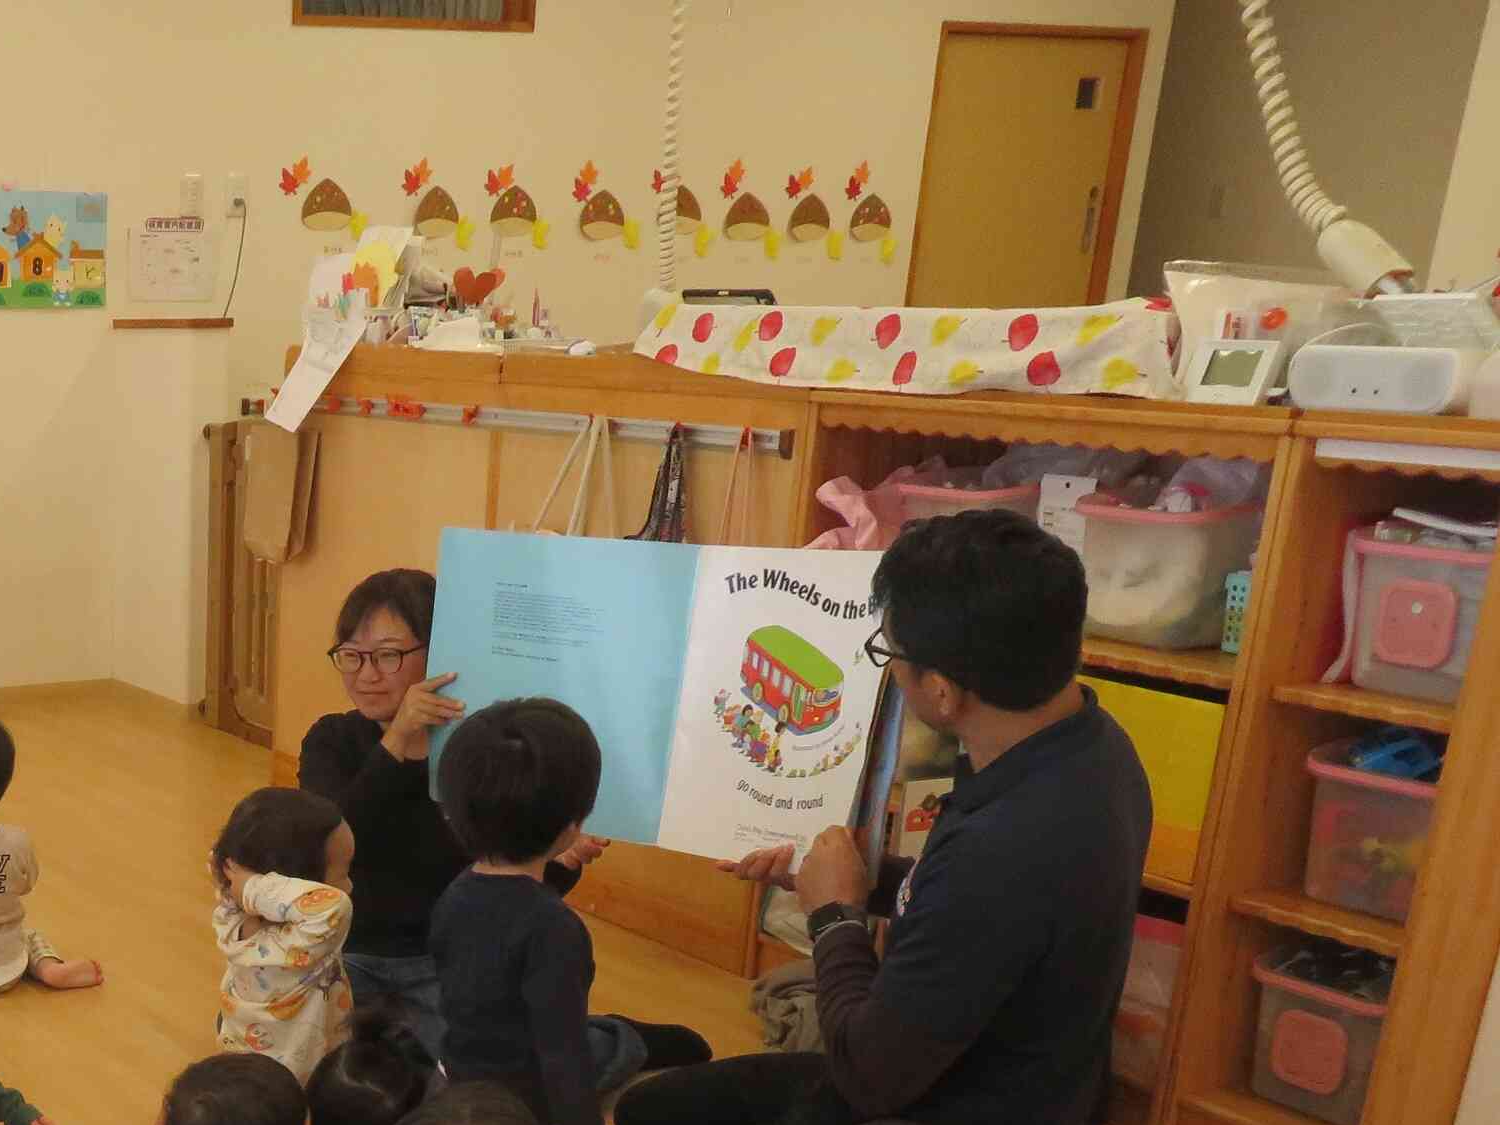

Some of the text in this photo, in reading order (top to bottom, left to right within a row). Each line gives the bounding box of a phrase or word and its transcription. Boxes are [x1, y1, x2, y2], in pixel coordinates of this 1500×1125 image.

[725, 572, 758, 594] The
[763, 568, 822, 606] Wheels
[821, 598, 840, 617] on
[842, 600, 867, 619] the
[736, 779, 824, 809] go round and round
